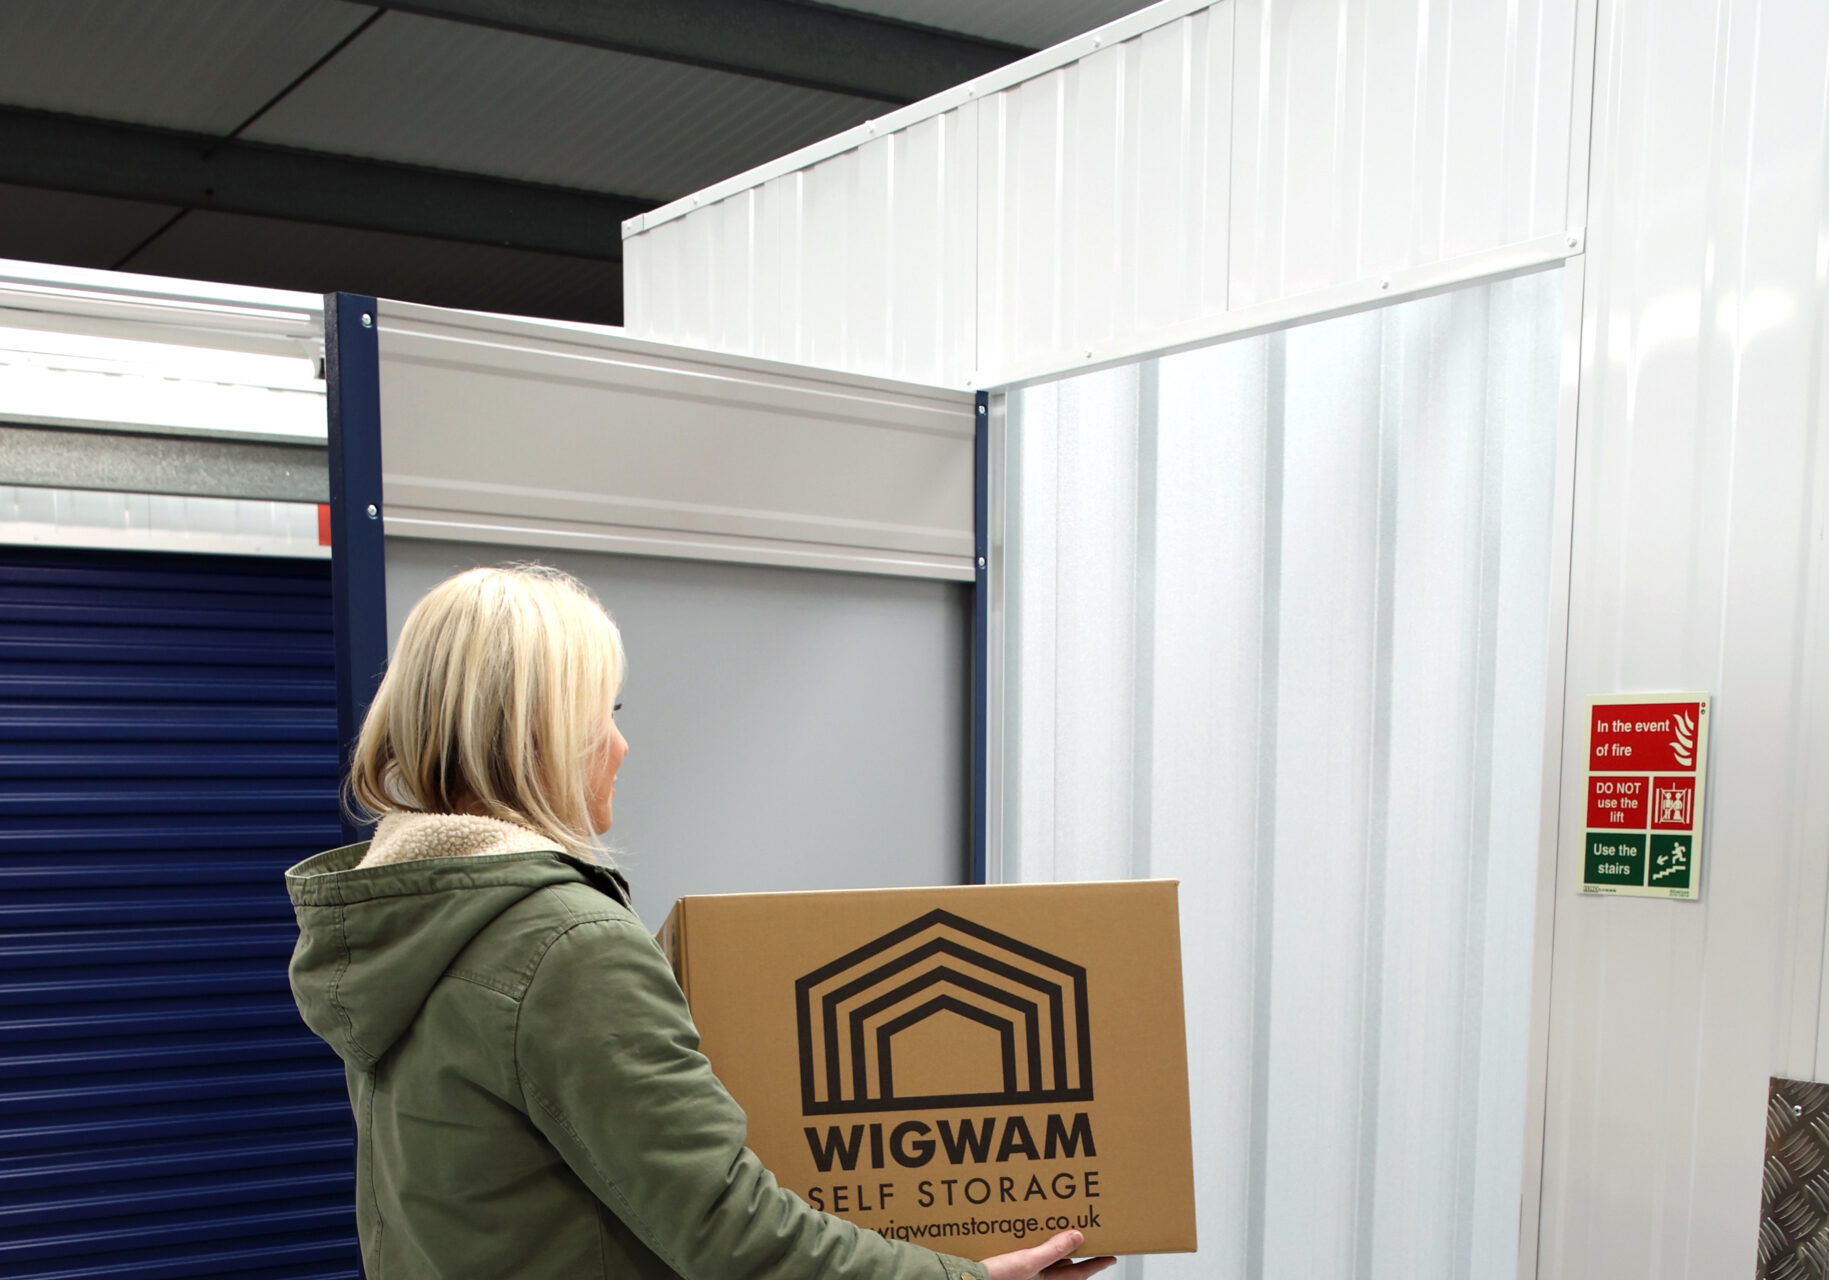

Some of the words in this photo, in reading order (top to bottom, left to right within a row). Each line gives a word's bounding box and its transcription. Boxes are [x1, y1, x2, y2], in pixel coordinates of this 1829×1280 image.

[1597, 720, 1609, 733] In
[1612, 719, 1632, 732] the
[1635, 719, 1670, 732] event
[1596, 743, 1609, 757] of
[1612, 743, 1632, 757] fire
[1596, 782, 1613, 794] DO
[1616, 782, 1642, 794] NOT
[1597, 799, 1618, 808] use
[1620, 797, 1638, 809] the
[1610, 811, 1625, 823] lift
[1593, 843, 1616, 856] Use
[1618, 844, 1638, 857] the
[1598, 862, 1631, 875] stairs
[803, 1112, 1097, 1172] WIGWAM
[808, 1183, 894, 1212] SELF
[917, 1171, 1101, 1208] STORAGE
